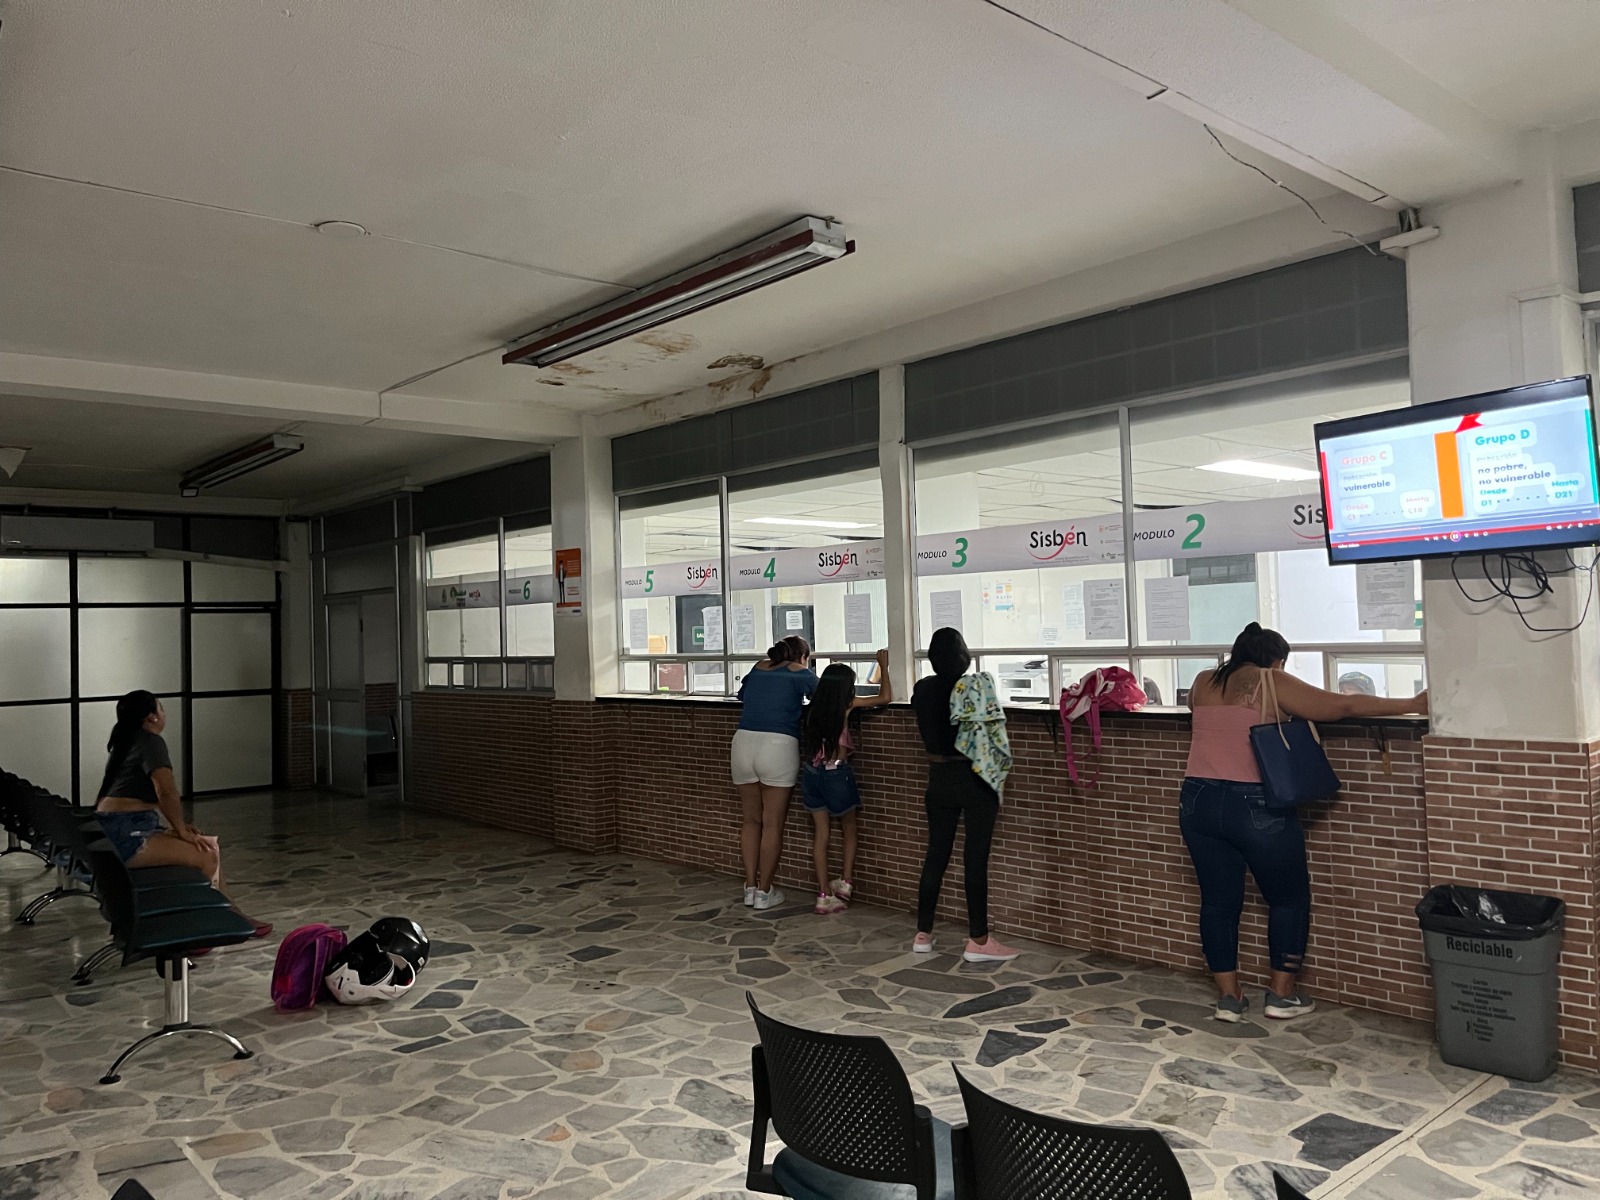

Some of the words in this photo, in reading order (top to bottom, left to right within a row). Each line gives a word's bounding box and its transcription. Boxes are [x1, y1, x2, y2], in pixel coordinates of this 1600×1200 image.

[1475, 433, 1516, 446] Grupo
[1520, 429, 1530, 439] D
[1341, 454, 1376, 466] Grupo
[1379, 450, 1387, 460] C
[1493, 463, 1527, 474] pobre,
[1494, 470, 1551, 483] vulnerable
[1344, 480, 1391, 492] vulnerable
[1551, 479, 1579, 487] Hasta
[1555, 490, 1573, 498] D21
[1293, 504, 1324, 525] Sis
[1029, 525, 1089, 549] Sisbén
[1133, 529, 1175, 541] MODULO
[1181, 513, 1205, 550] 2
[818, 548, 859, 568] Sisbén
[917, 550, 947, 560] MODULO
[952, 537, 969, 568] 3
[686, 563, 718, 580] Sisbén
[739, 567, 761, 576] MODULO
[763, 557, 776, 582] 4
[523, 580, 531, 601] 6
[644, 569, 654, 593] 5
[1446, 936, 1513, 958] Reciclable
